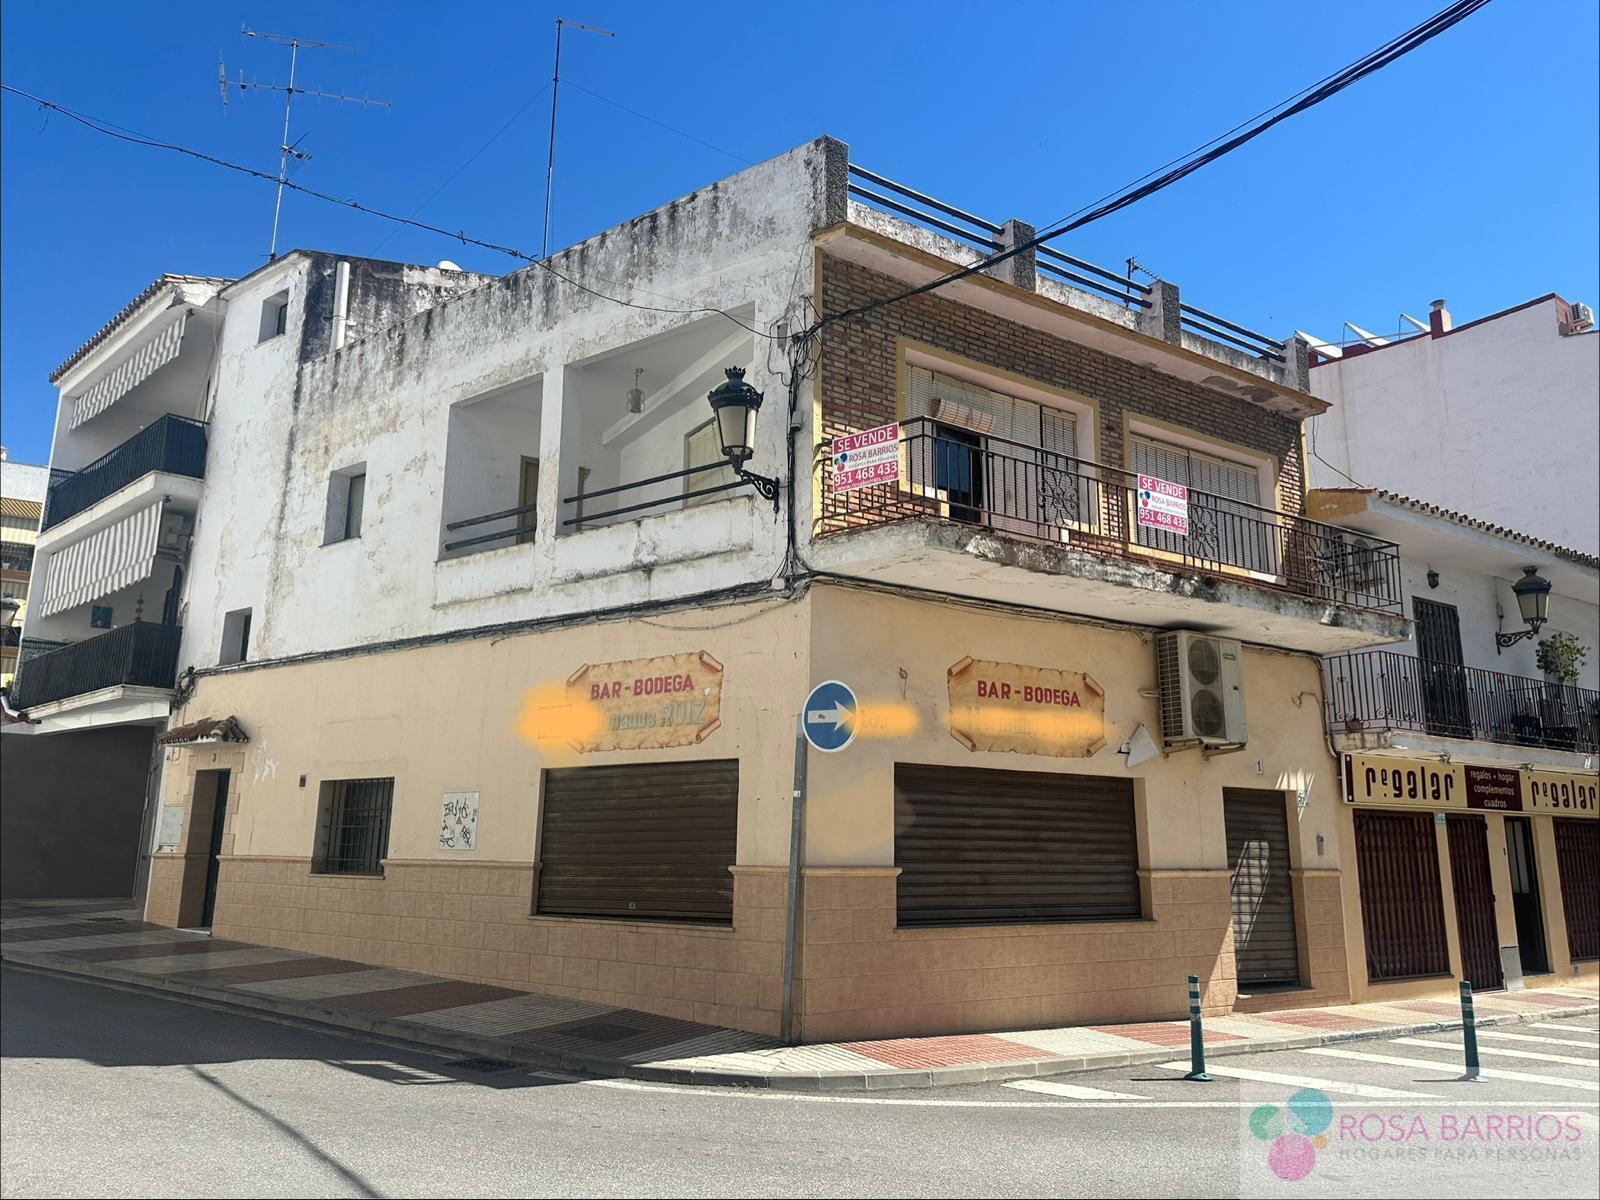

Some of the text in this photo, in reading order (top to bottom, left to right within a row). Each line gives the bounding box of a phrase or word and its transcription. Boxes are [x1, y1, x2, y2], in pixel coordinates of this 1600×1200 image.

[838, 427, 893, 452] SE VENDE
[848, 444, 898, 463] ROSA BARRIOS
[834, 462, 897, 487] 951 468 433
[1142, 477, 1183, 498] SE VENDE
[1151, 495, 1165, 505] ROSA
[1140, 509, 1154, 521] 951
[1156, 513, 1171, 524] 468
[1172, 517, 1187, 528] 433
[660, 700, 705, 728] RUIZ
[1364, 765, 1455, 801] regalar
[1470, 770, 1514, 784] regalos hogar
[1473, 783, 1515, 796] complementos
[1531, 779, 1597, 810] regalar
[1484, 798, 1507, 808] cuadros
